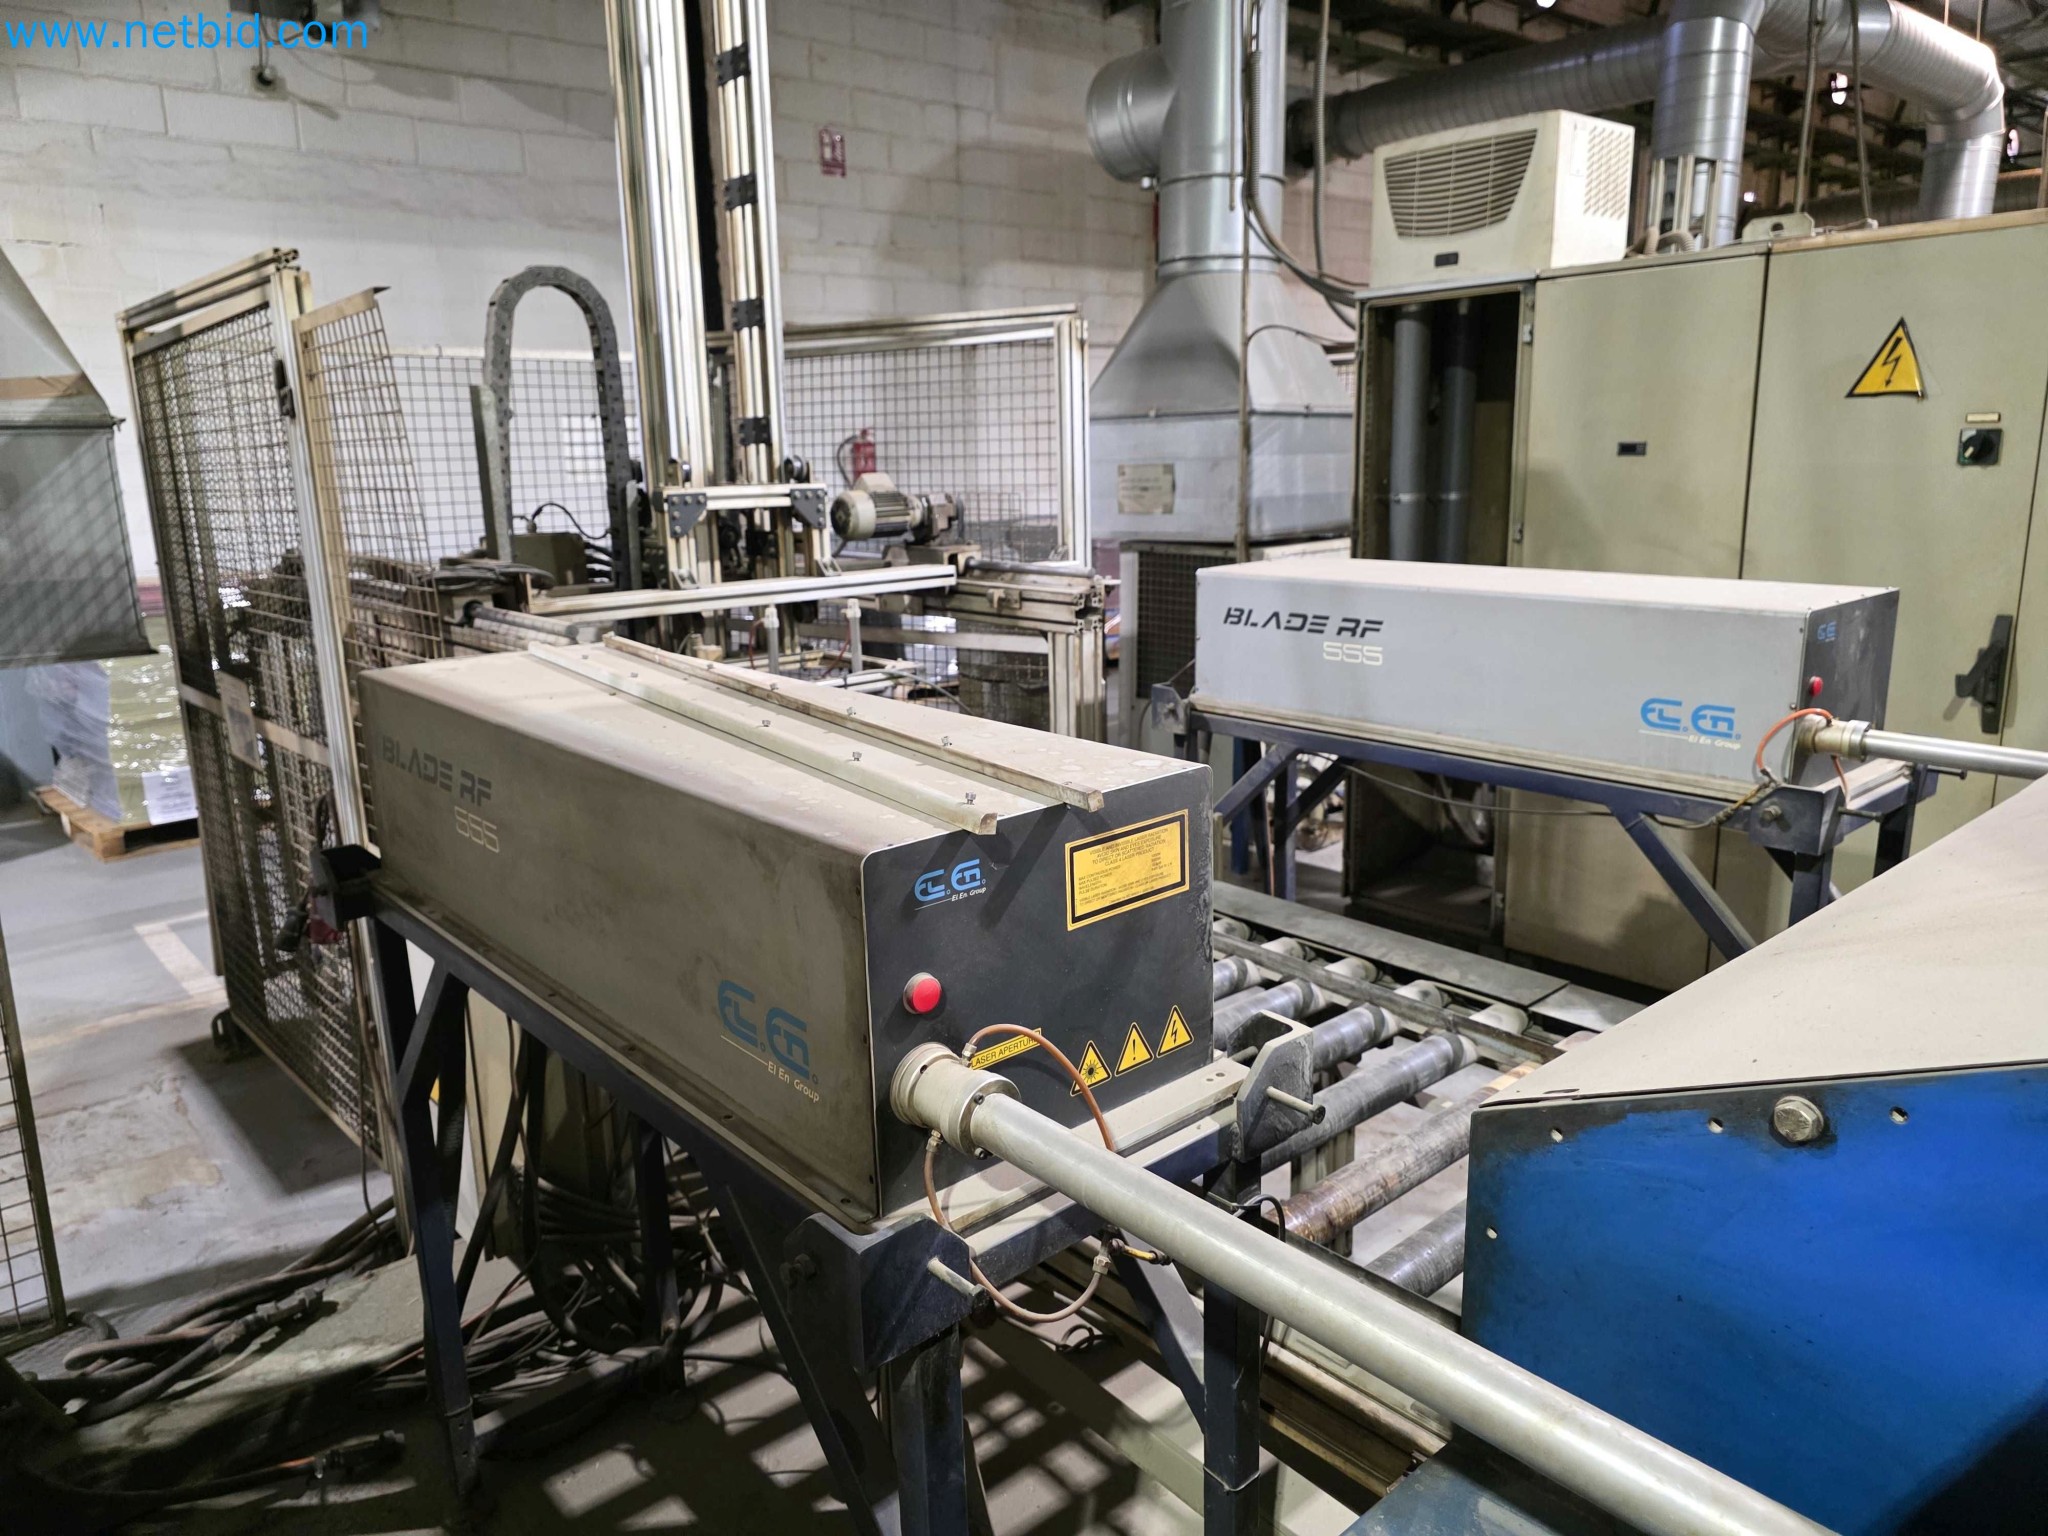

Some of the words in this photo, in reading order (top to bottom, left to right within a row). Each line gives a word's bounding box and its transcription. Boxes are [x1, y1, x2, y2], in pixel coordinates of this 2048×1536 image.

[1223, 607, 1330, 634] BLADE
[1336, 617, 1384, 638] RF
[382, 735, 453, 792] BLADE
[460, 769, 492, 807] RF
[970, 887, 987, 896] Group
[972, 1051, 997, 1068] LASER
[793, 1079, 820, 1103] Group
